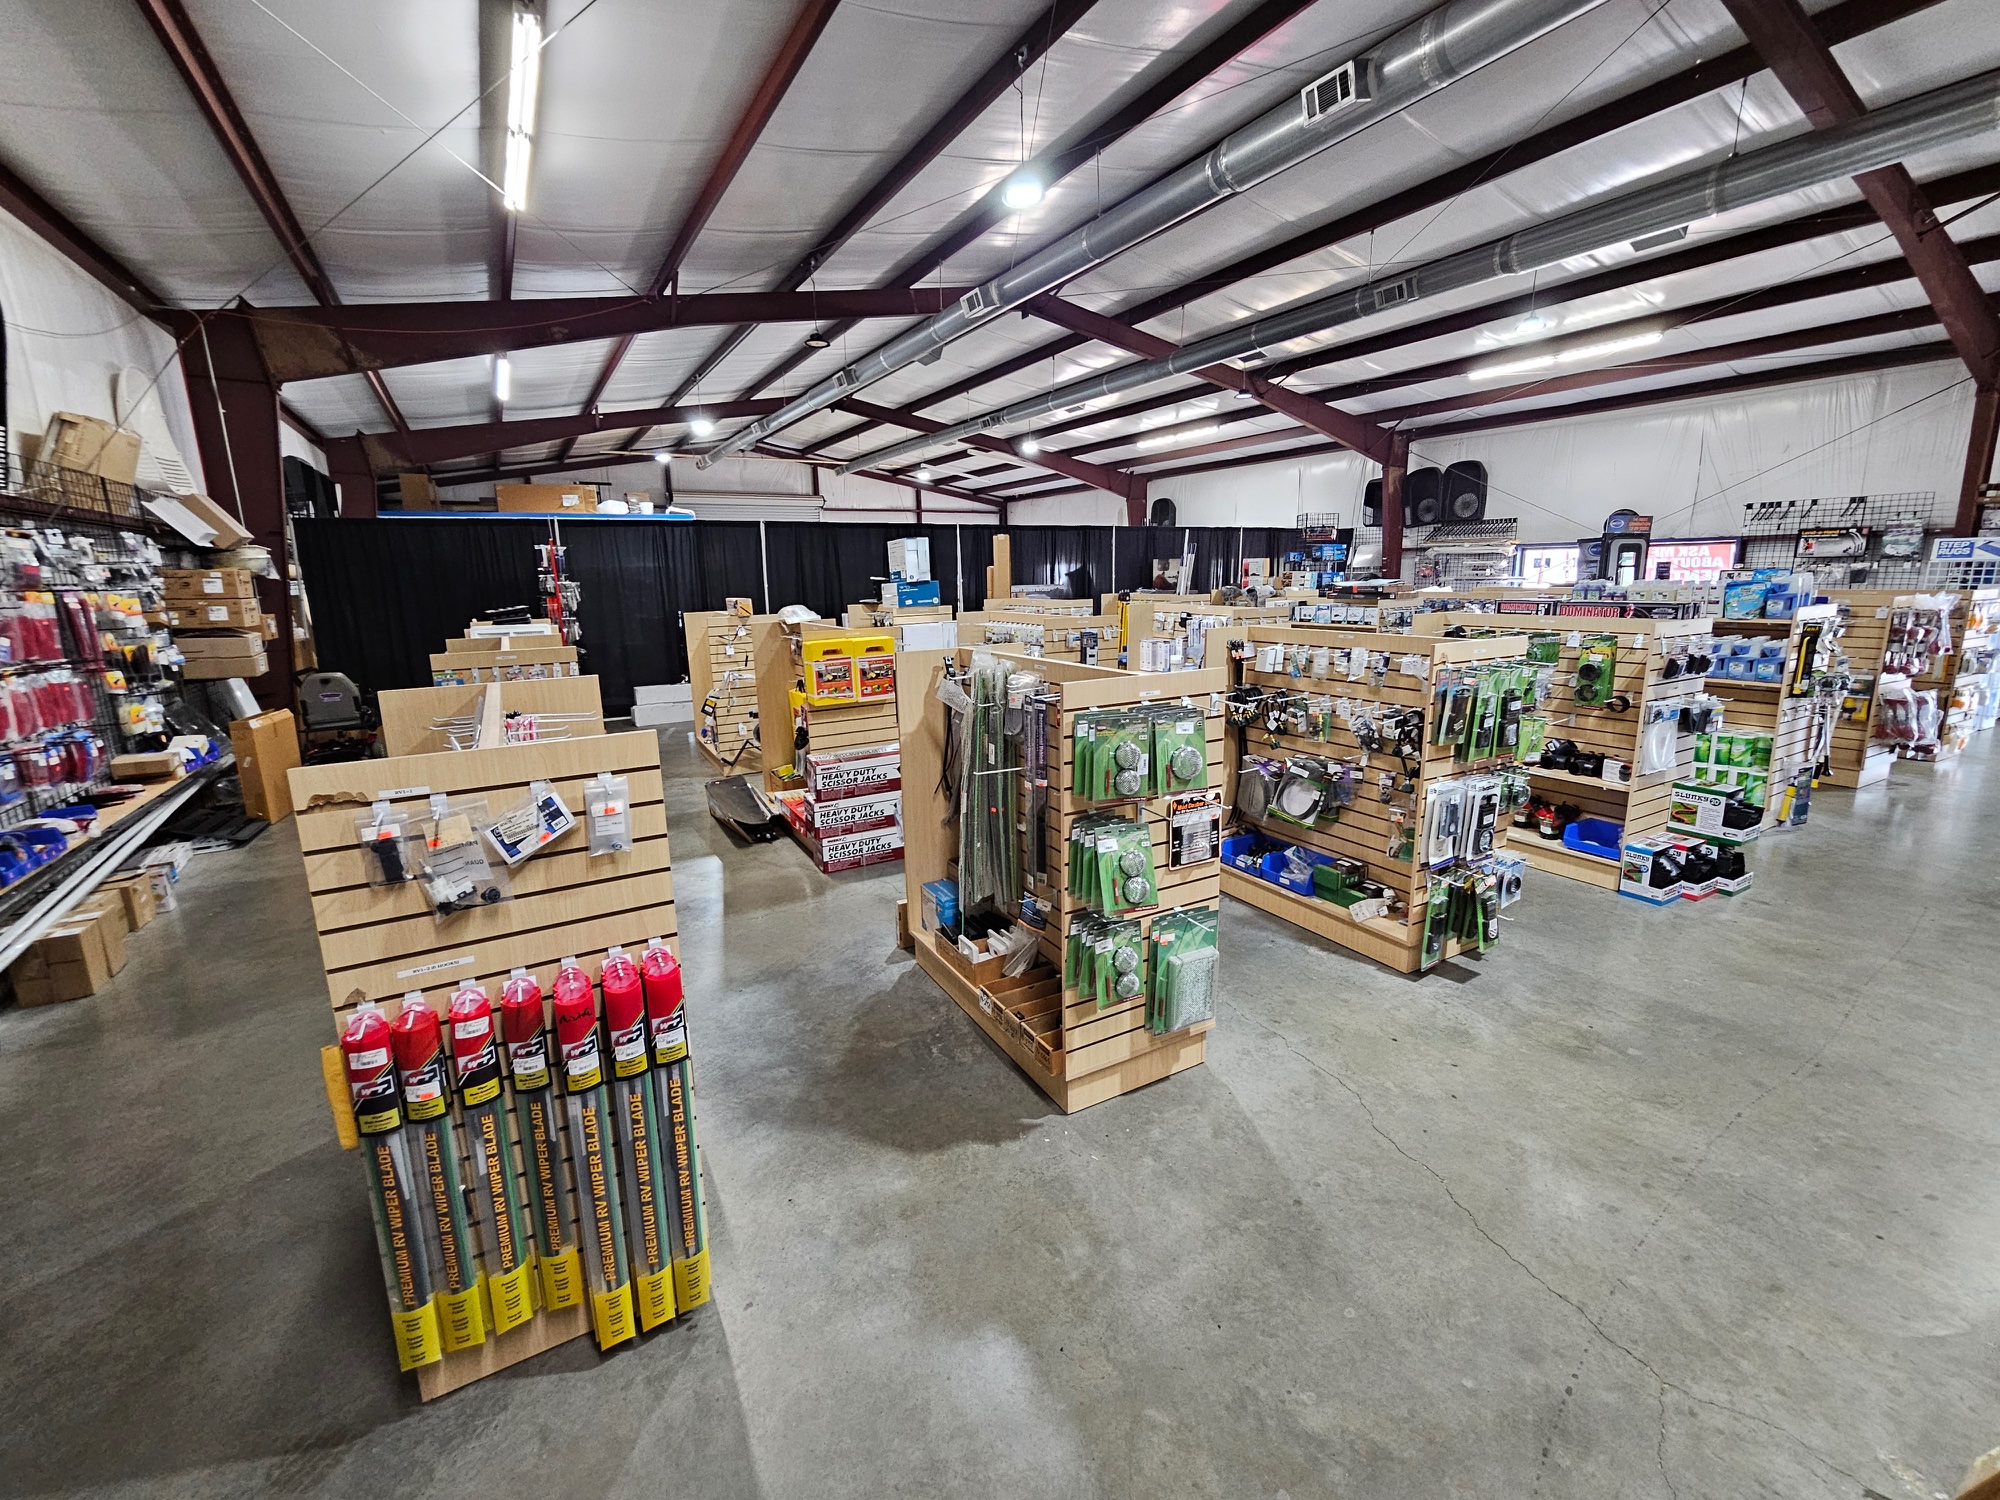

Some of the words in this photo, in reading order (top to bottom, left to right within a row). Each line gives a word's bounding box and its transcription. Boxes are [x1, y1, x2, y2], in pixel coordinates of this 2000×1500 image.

[1940, 541, 1970, 549] STEP
[1560, 605, 1620, 618] DOMINATOR
[822, 771, 852, 781] HEAVY
[853, 768, 877, 776] DUTY
[822, 777, 858, 788] SCISSOR
[860, 772, 888, 782] JACKS
[820, 808, 850, 819] HEAVY
[850, 804, 874, 814] DUTY
[1674, 792, 1710, 802] SLUNKY
[820, 815, 856, 826] SCISSOR
[858, 809, 885, 819] JACKS
[828, 842, 857, 853] HEAVY
[858, 838, 882, 848] DUTY
[828, 849, 864, 860] SCISSOR
[865, 842, 892, 853] JACKS
[629, 1093, 646, 1138] BLADE
[670, 1078, 684, 1122] BLADE
[481, 1114, 498, 1154] BLADE
[530, 1102, 547, 1141] BLADE
[582, 1106, 600, 1152] BLADE
[378, 1145, 396, 1187] BLADE
[424, 1133, 441, 1173] BLADE
[537, 1144, 552, 1183] WIPER
[634, 1140, 650, 1184] WIPER
[674, 1125, 688, 1168] WIPER
[486, 1155, 503, 1193] WIPER
[542, 1184, 554, 1199] RV
[589, 1154, 606, 1197] WIPER
[679, 1170, 691, 1187] RV
[386, 1190, 403, 1228] WIPER
[432, 1176, 449, 1215] WIPER
[493, 1194, 507, 1212] RV
[595, 1201, 608, 1218] RV
[640, 1186, 652, 1203] RV
[439, 1216, 452, 1232] RV
[545, 1200, 561, 1250] PREMIUM
[642, 1205, 659, 1264] PREMIUM
[681, 1189, 696, 1247] PREMIUM
[392, 1230, 406, 1248] RV
[495, 1213, 514, 1268] PREMIUM
[597, 1221, 616, 1281] PREMIUM
[396, 1254, 414, 1306] PREMIUM
[442, 1234, 460, 1289] PREMIUM
